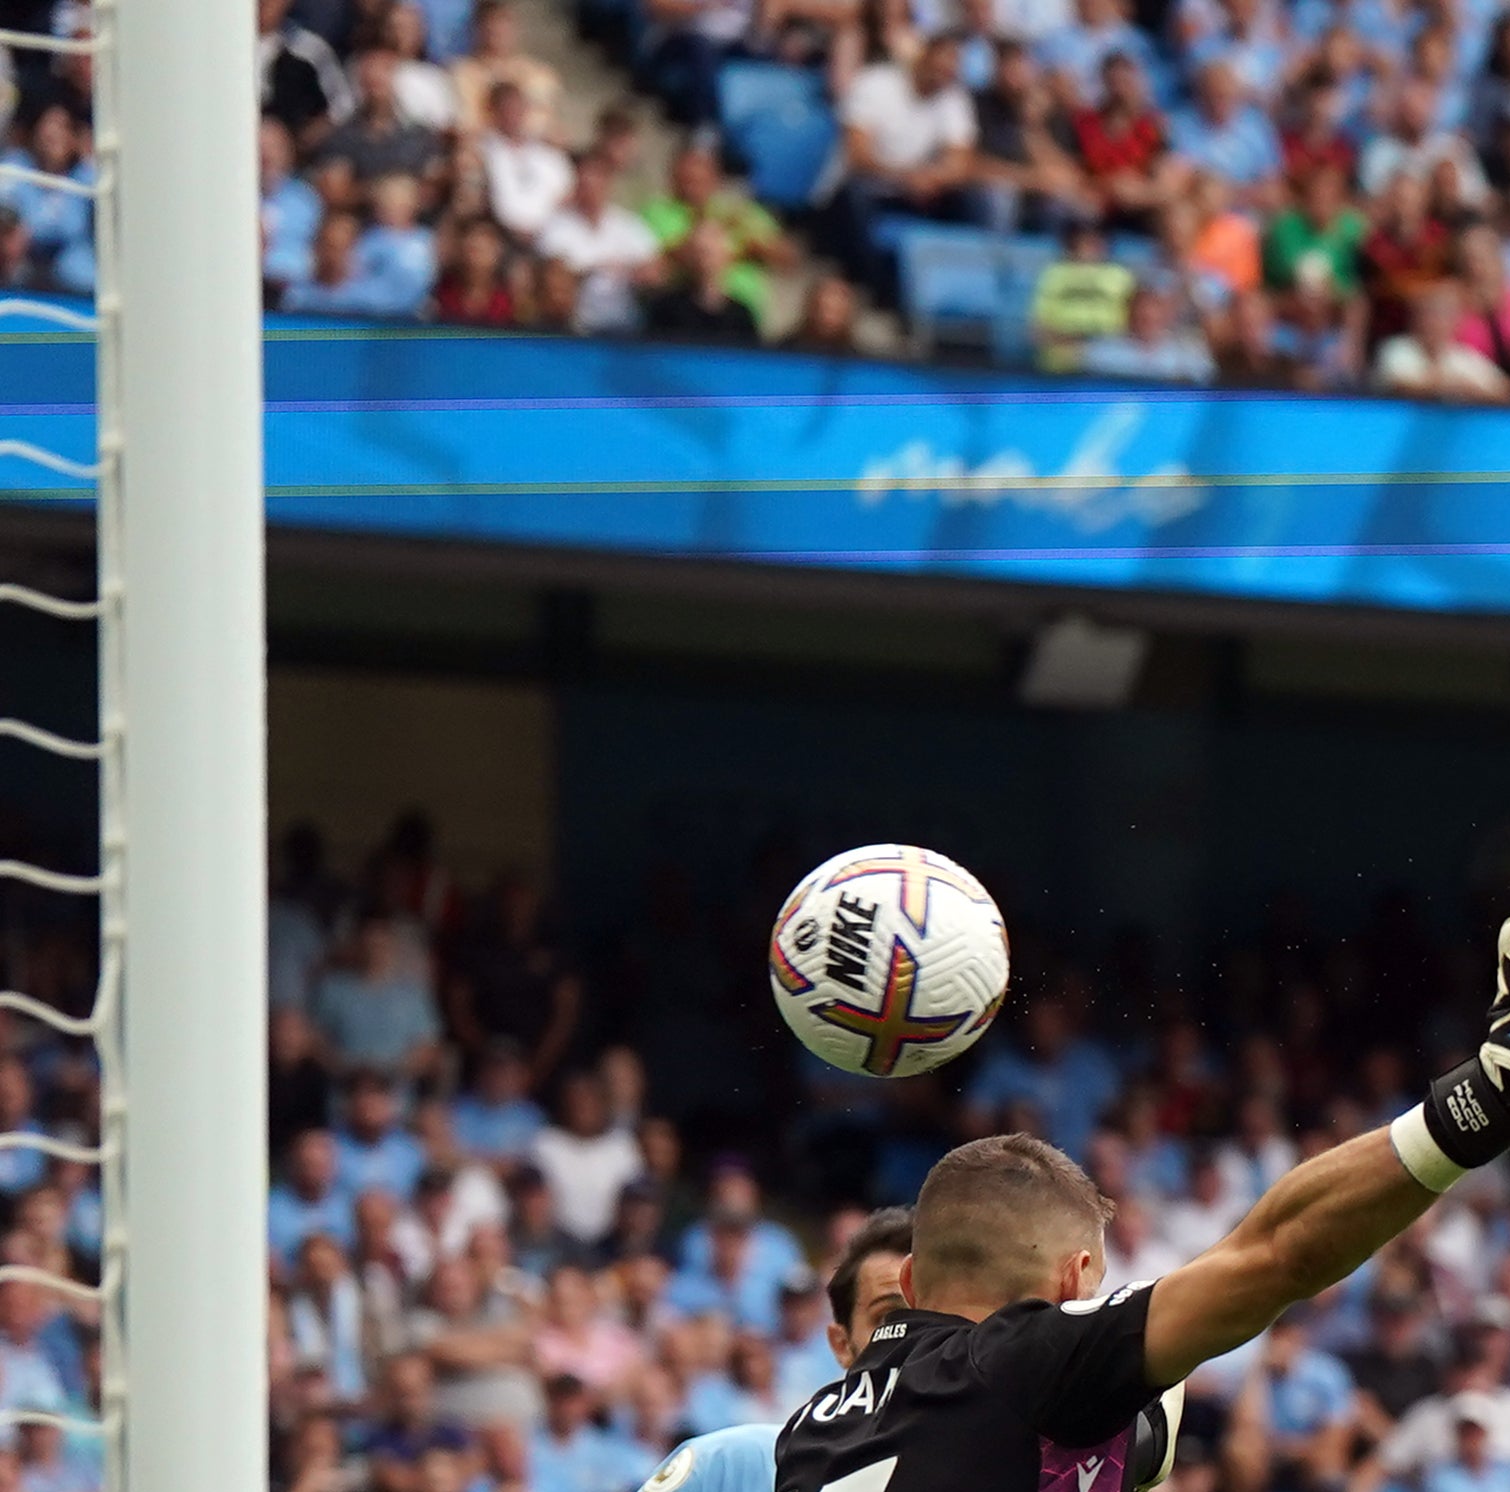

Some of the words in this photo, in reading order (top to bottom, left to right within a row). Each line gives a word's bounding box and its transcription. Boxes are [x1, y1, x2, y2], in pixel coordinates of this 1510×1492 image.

[826, 890, 878, 992] NIKE
[1453, 1084, 1481, 1132] PACO
[1460, 1078, 1490, 1127] HUGO
[872, 1323, 908, 1343] EAGLES
